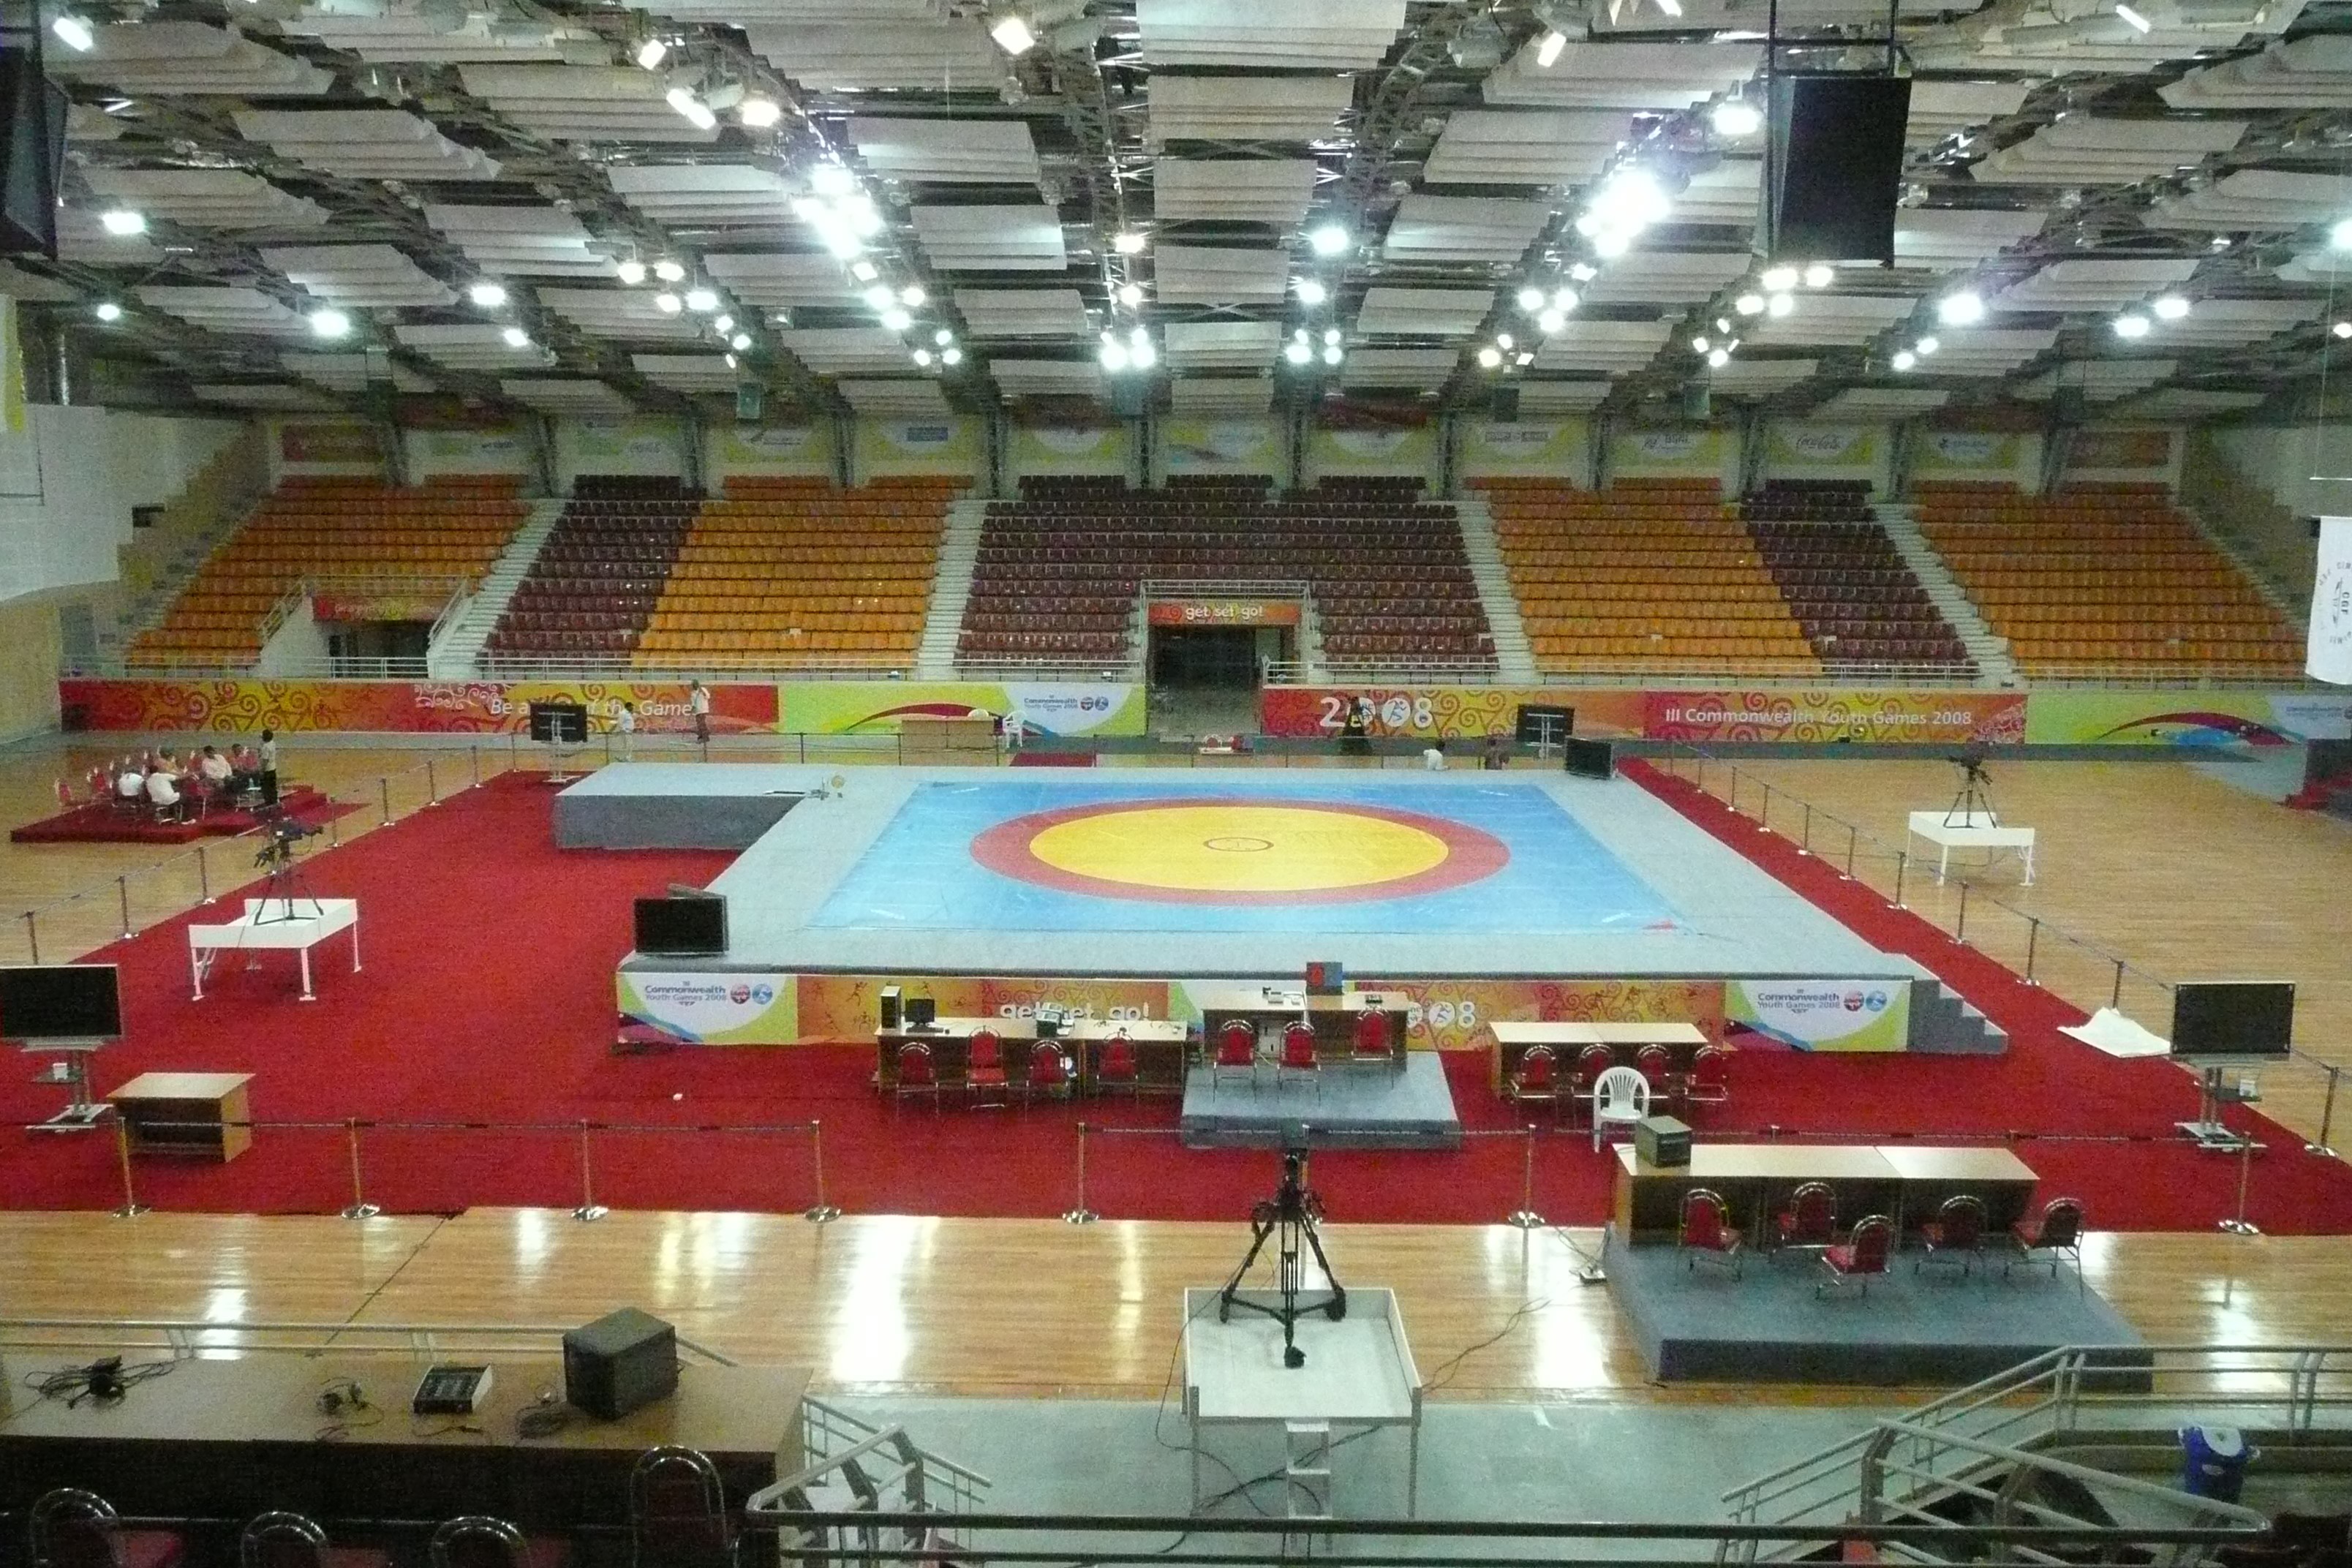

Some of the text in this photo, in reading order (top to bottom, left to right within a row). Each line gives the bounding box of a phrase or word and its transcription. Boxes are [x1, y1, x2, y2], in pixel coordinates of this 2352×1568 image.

[1186, 605, 1264, 621] get set go!
[491, 699, 513, 715] Be
[518, 702, 529, 715] a
[639, 699, 693, 717] Game
[1665, 708, 1972, 725] III Commonwealth Youth Games 2008
[645, 985, 725, 994] Commonwealth
[1757, 992, 1840, 1002] Commonwealth
[1757, 1001, 1840, 1009] Youth Games 2008
